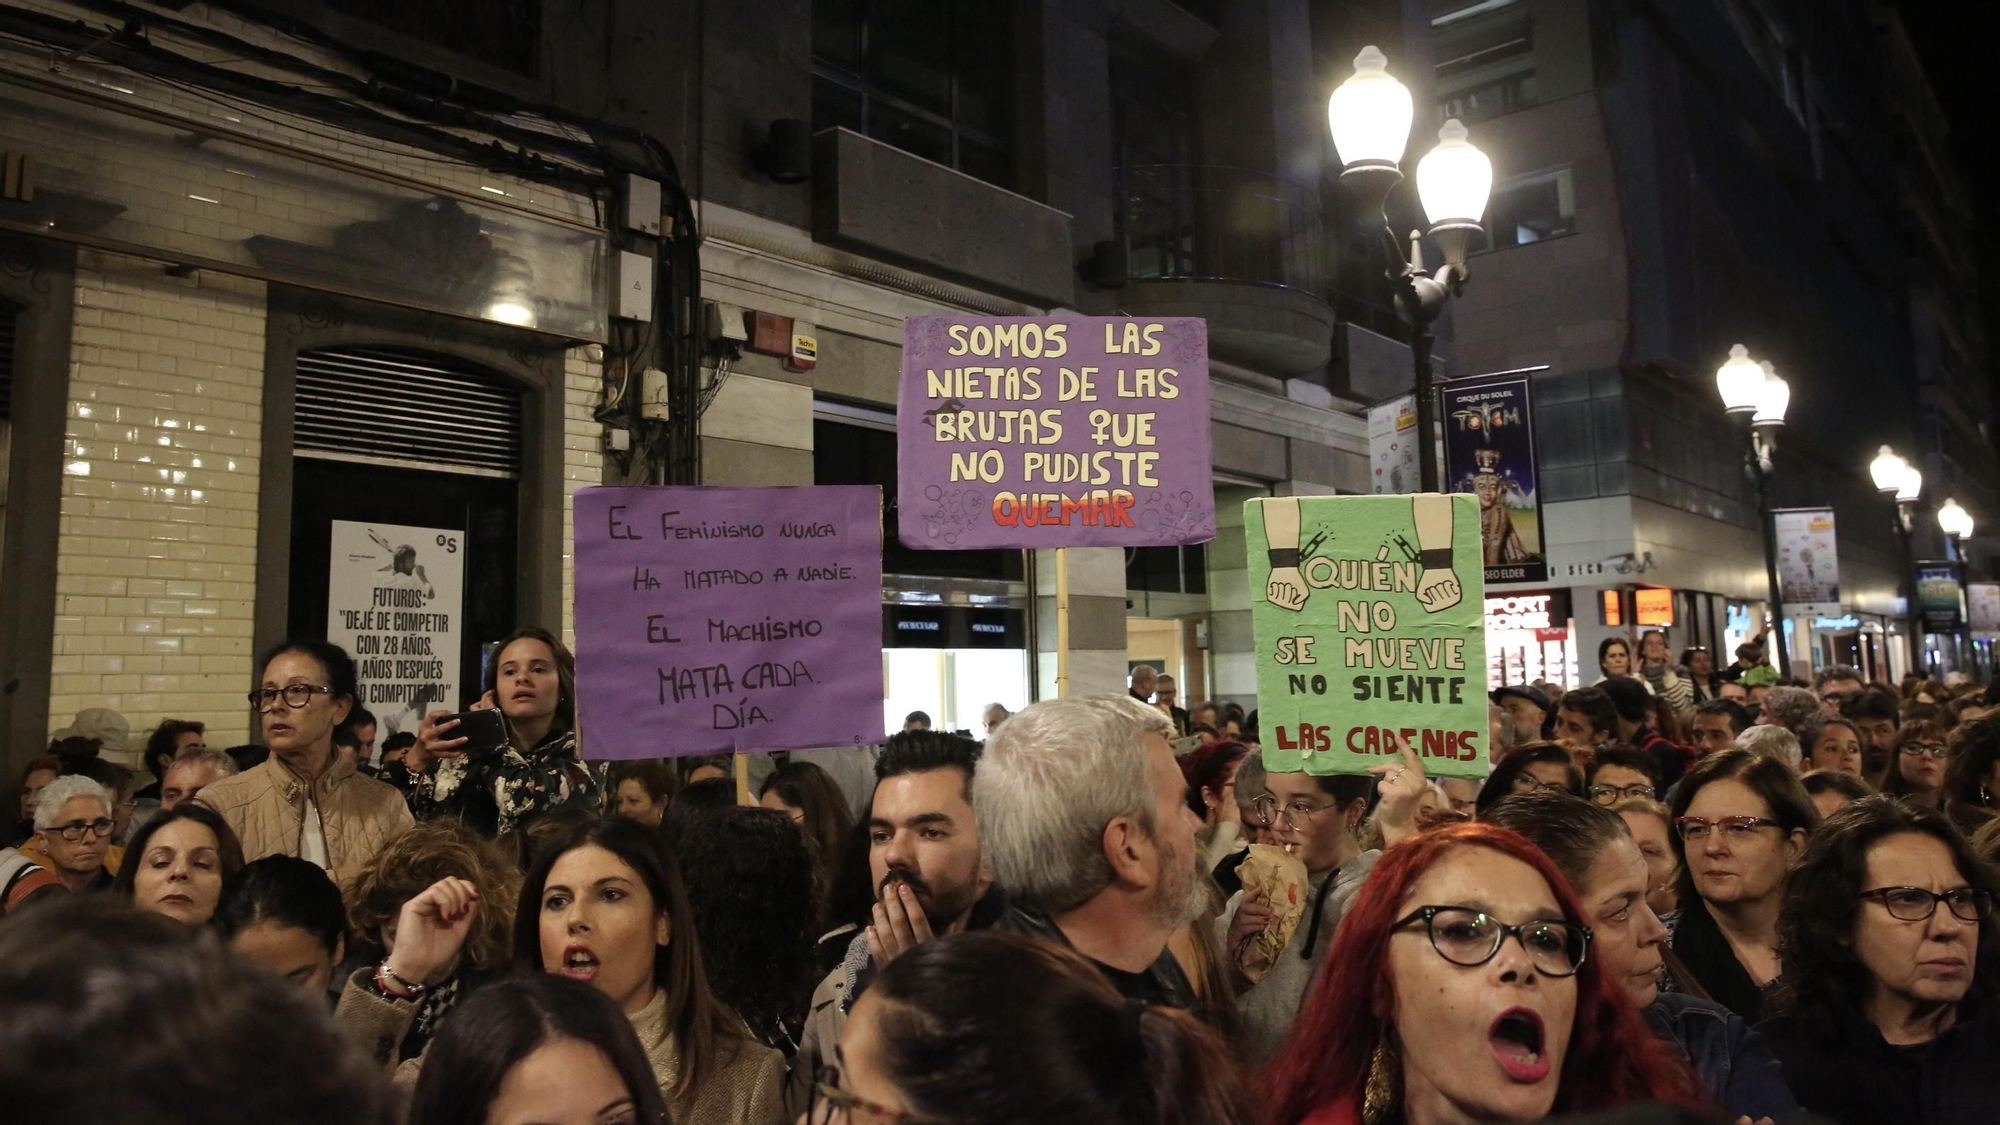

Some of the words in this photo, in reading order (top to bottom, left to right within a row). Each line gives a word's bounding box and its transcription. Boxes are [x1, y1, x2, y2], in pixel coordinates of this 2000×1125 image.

[948, 323, 1068, 359] SOMOS
[1105, 322, 1164, 356] LAS
[926, 366, 1042, 400] NIETAS
[1058, 367, 1099, 402] DE
[1117, 367, 1179, 399] LAS
[1457, 394, 1479, 403] CIRQUE
[1491, 390, 1514, 398] SOLEIL
[935, 409, 1062, 445] BRUJAS
[950, 449, 1004, 484] NO
[1023, 450, 1160, 487] PUDISTE
[991, 488, 1136, 529] QUEMAR
[684, 569, 764, 590] MATADO
[773, 567, 789, 583] A
[1304, 545, 1416, 594] QUIÉN
[1485, 569, 1500, 580] SEO
[1501, 568, 1525, 578] ELDER
[373, 587, 427, 608] FUTUROS:
[377, 612, 391, 632] DE
[393, 612, 449, 633] COMPETIR
[1337, 600, 1397, 633] NO
[356, 635, 380, 655] CON
[384, 636, 398, 655] 28
[401, 633, 434, 656] AÑOS.
[1274, 636, 1317, 665] SE
[1344, 637, 1466, 670] MUEVE
[361, 656, 392, 680] AÑOS
[396, 656, 443, 680] DESPUÉS
[657, 663, 735, 705] MATA
[741, 660, 821, 690] CADA.
[1288, 674, 1328, 695] NO
[1352, 675, 1466, 705] SIENTE
[713, 697, 773, 730] DÍA.
[1275, 722, 1331, 751] LAS
[1346, 725, 1479, 762] CADENAS
